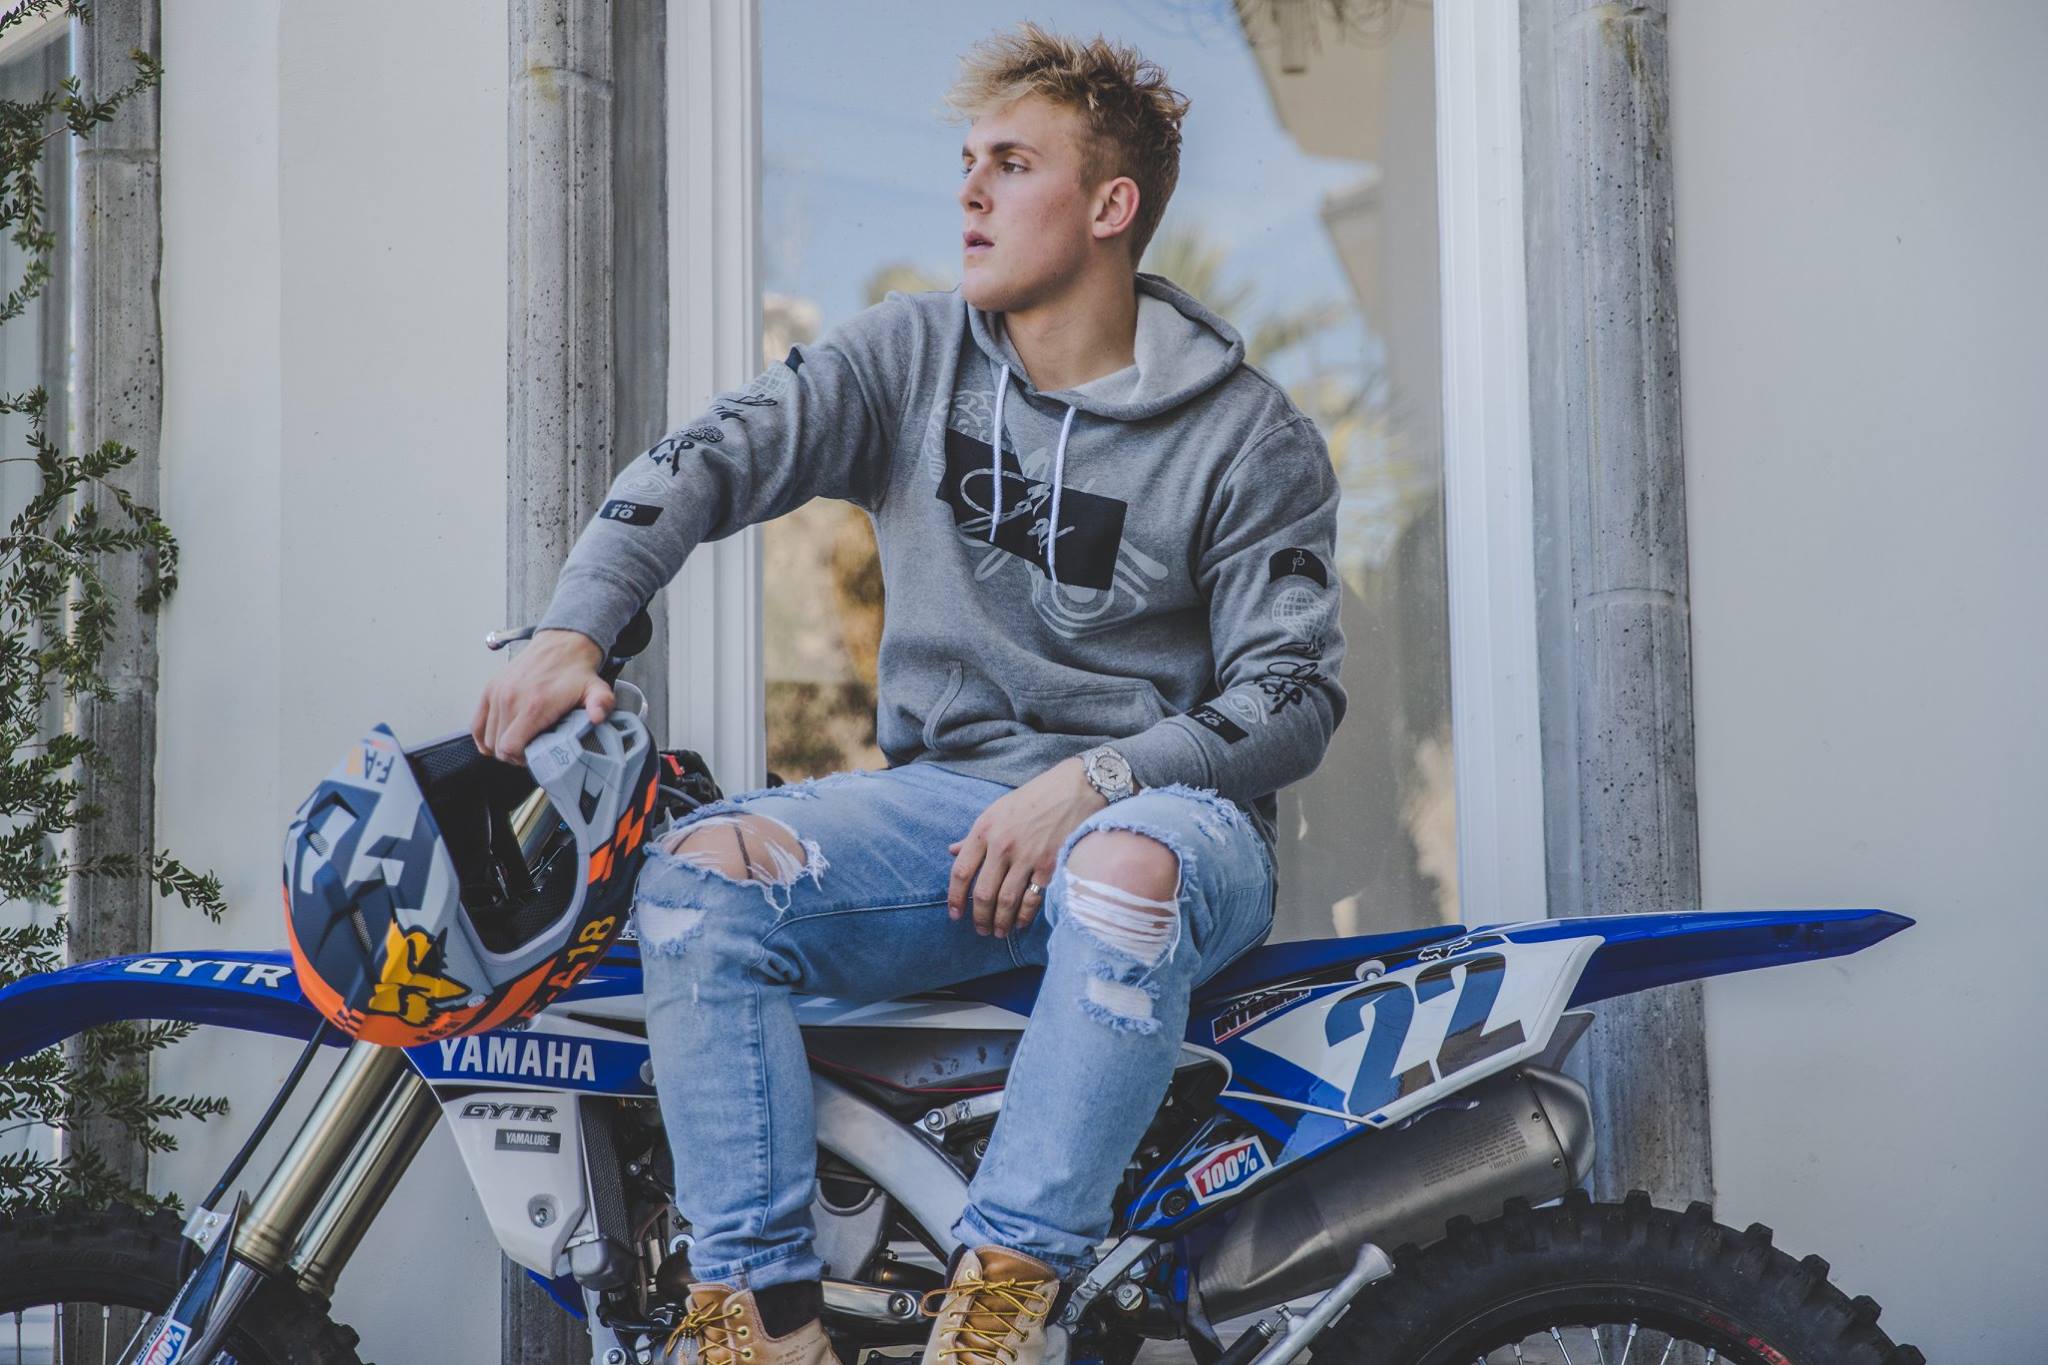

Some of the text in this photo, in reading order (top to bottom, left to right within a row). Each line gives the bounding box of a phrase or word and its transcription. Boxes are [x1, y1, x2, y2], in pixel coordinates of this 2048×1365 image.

[123, 957, 293, 989] GYTR
[1324, 952, 1527, 1118] 22
[439, 1035, 596, 1082] YAMAHA
[459, 1101, 559, 1123] GYTR
[505, 1131, 551, 1146] YAMALUBE
[1200, 1146, 1258, 1194] 100%
